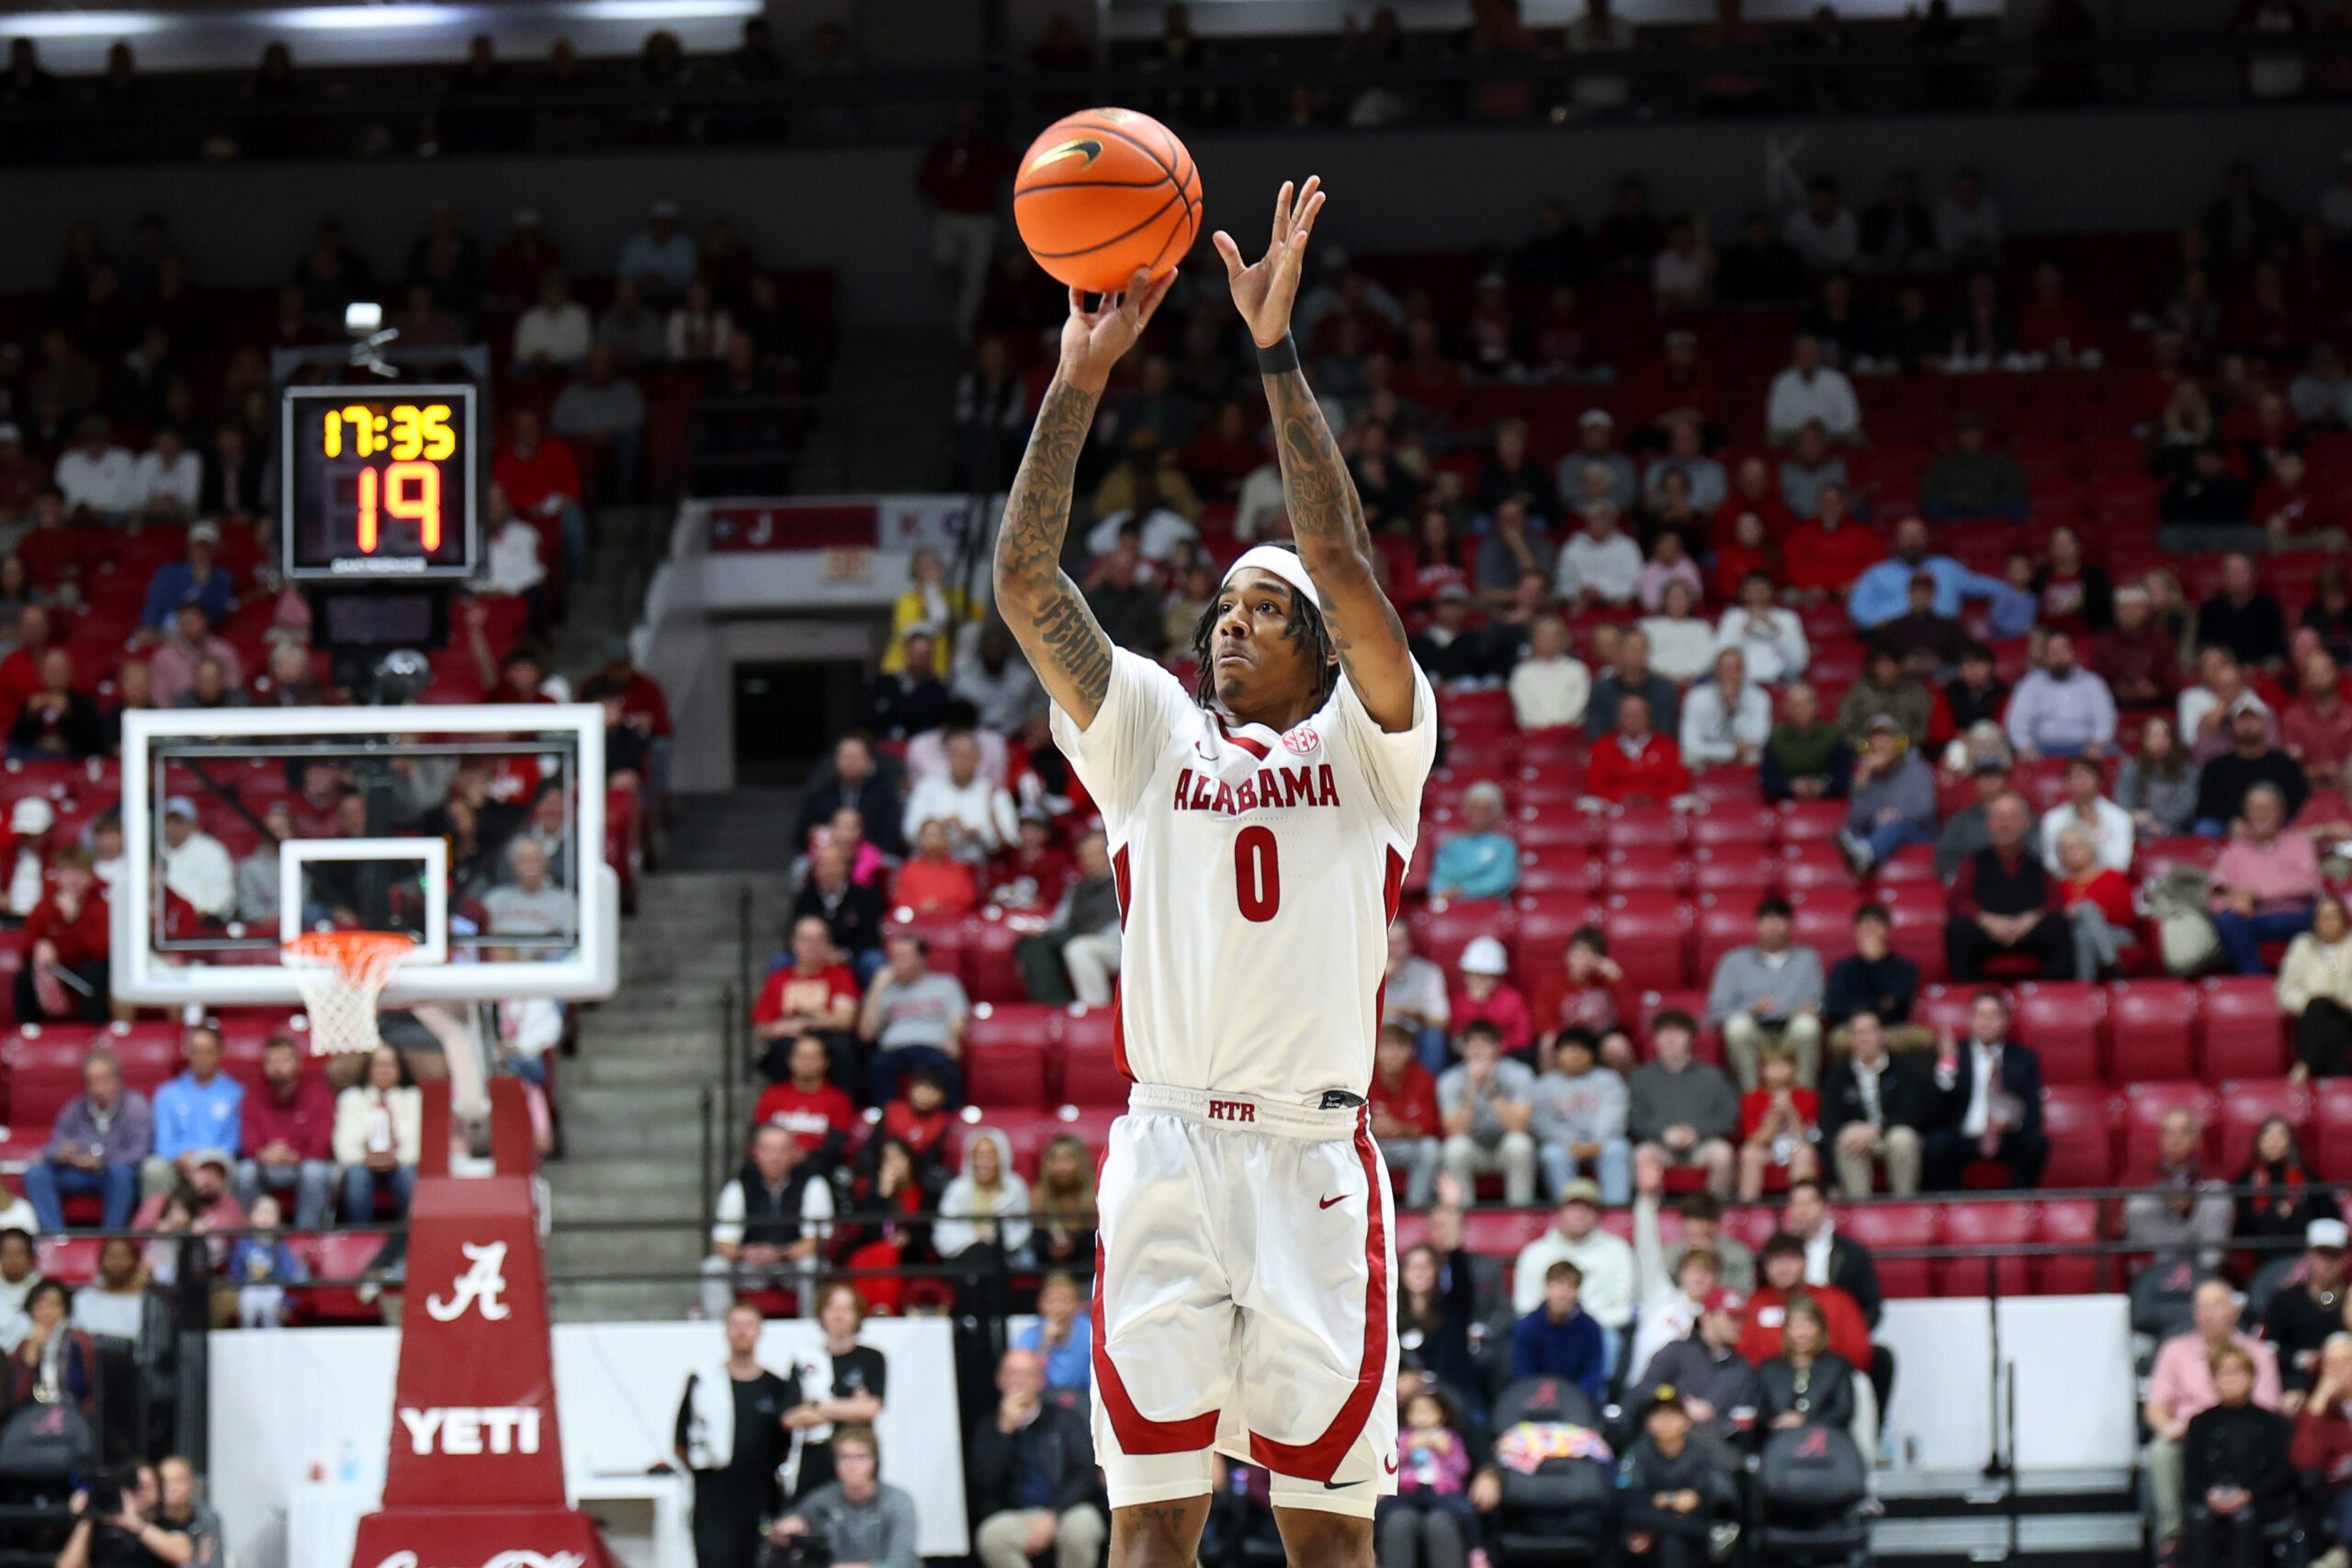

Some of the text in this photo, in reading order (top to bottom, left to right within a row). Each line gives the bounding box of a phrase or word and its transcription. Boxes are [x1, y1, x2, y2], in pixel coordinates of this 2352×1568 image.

[324, 404, 456, 460] 17:35
[357, 460, 441, 553] 19
[1283, 728, 1318, 751] SEC
[1174, 764, 1340, 815] ALABAMA
[1235, 826, 1280, 922] 0
[1208, 1100, 1255, 1122] RTR
[426, 1241, 511, 1320] A
[399, 1407, 540, 1455] YETI
